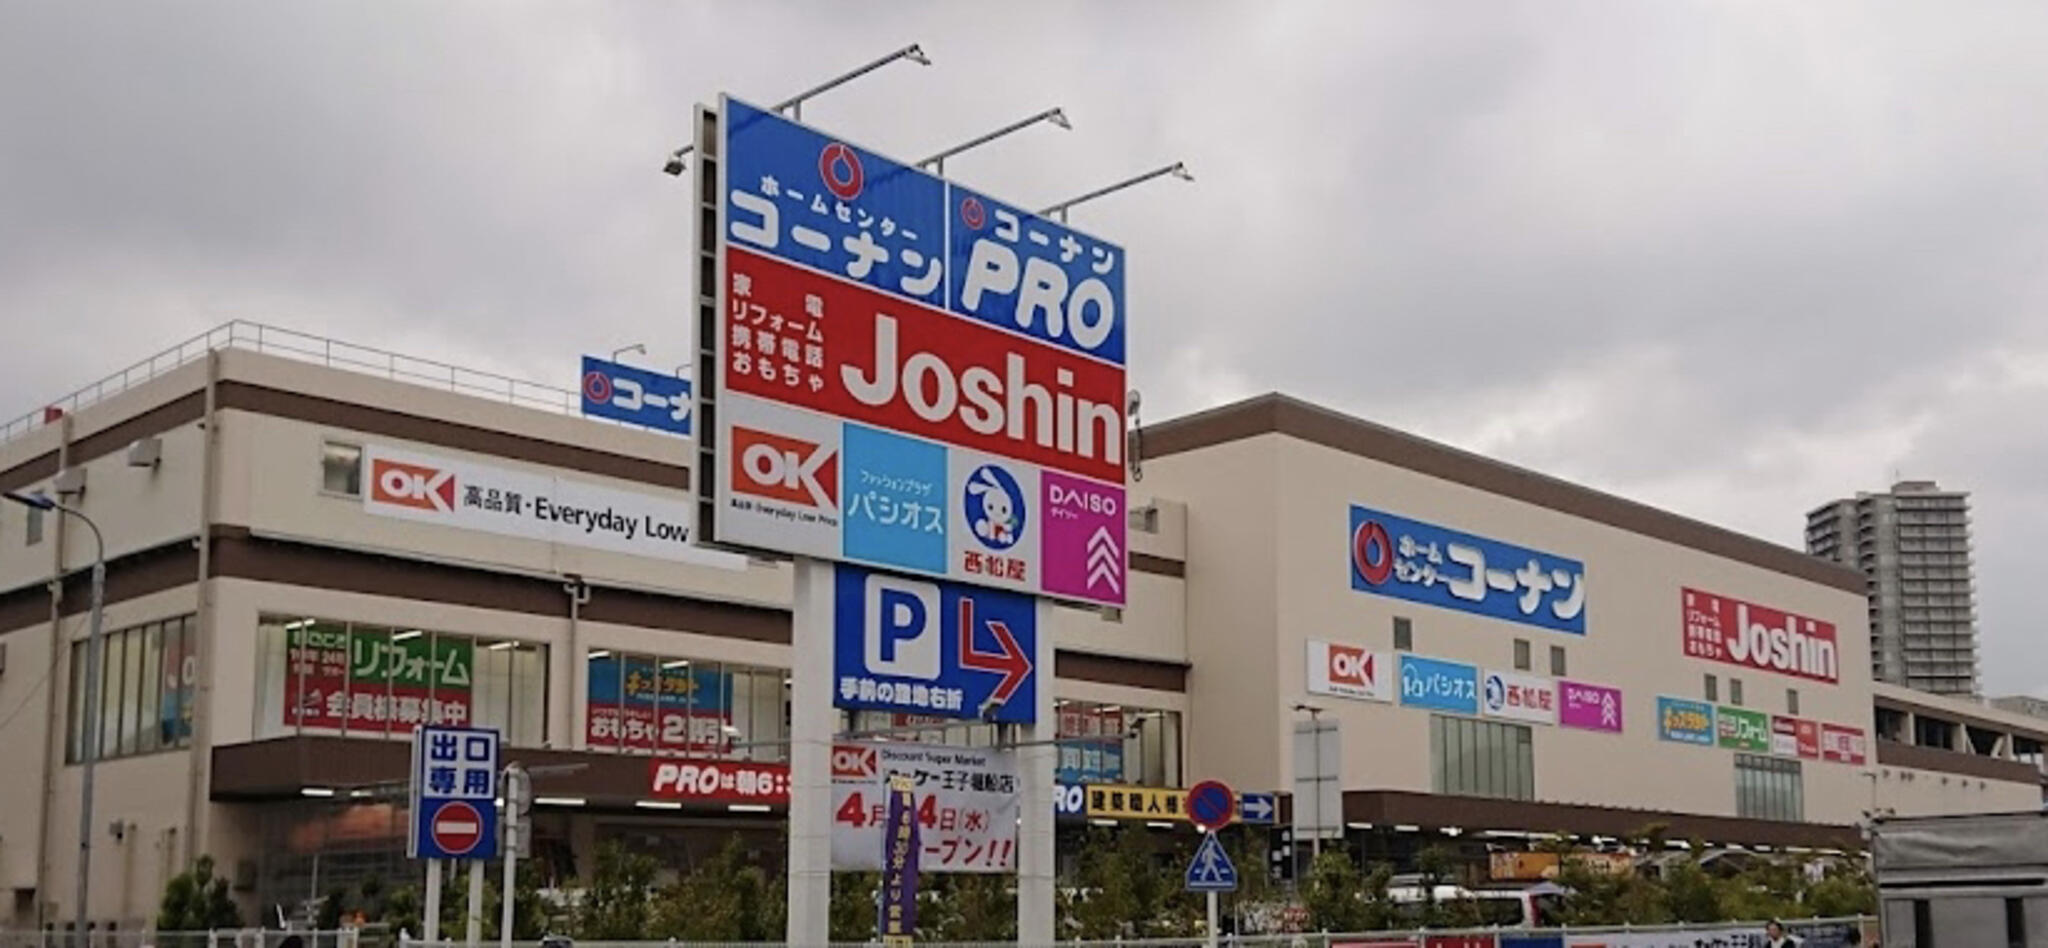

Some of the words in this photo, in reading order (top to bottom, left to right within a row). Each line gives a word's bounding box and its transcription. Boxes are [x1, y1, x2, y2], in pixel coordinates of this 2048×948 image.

[761, 174, 919, 241] ホームセンター
[730, 189, 942, 296] コーナン
[994, 209, 1114, 274] コーナン
[961, 238, 1114, 349] PRO
[733, 298, 823, 343] リフォーム
[732, 350, 824, 392] おもちゃ
[840, 312, 1121, 466] Joshin
[380, 469, 455, 513] OK
[742, 441, 838, 509] OK
[847, 490, 944, 535] パシオス
[1049, 484, 1116, 516] DAISO
[645, 515, 690, 543] Low
[1399, 534, 1443, 564] ホーム
[1394, 557, 1450, 587] センター
[1448, 543, 1585, 620] コーナン
[880, 588, 926, 662] P
[1727, 603, 1836, 679] Joshin
[354, 638, 470, 685] リフォーム
[1333, 650, 1375, 689] OK
[1425, 672, 1477, 699] パシオス
[431, 733, 490, 761] 出口
[832, 751, 877, 777] OK
[429, 765, 490, 794] 専用
[653, 764, 791, 795] PROは朝6:
[1054, 785, 1083, 812] RO
[924, 839, 1012, 866] ープン!!
